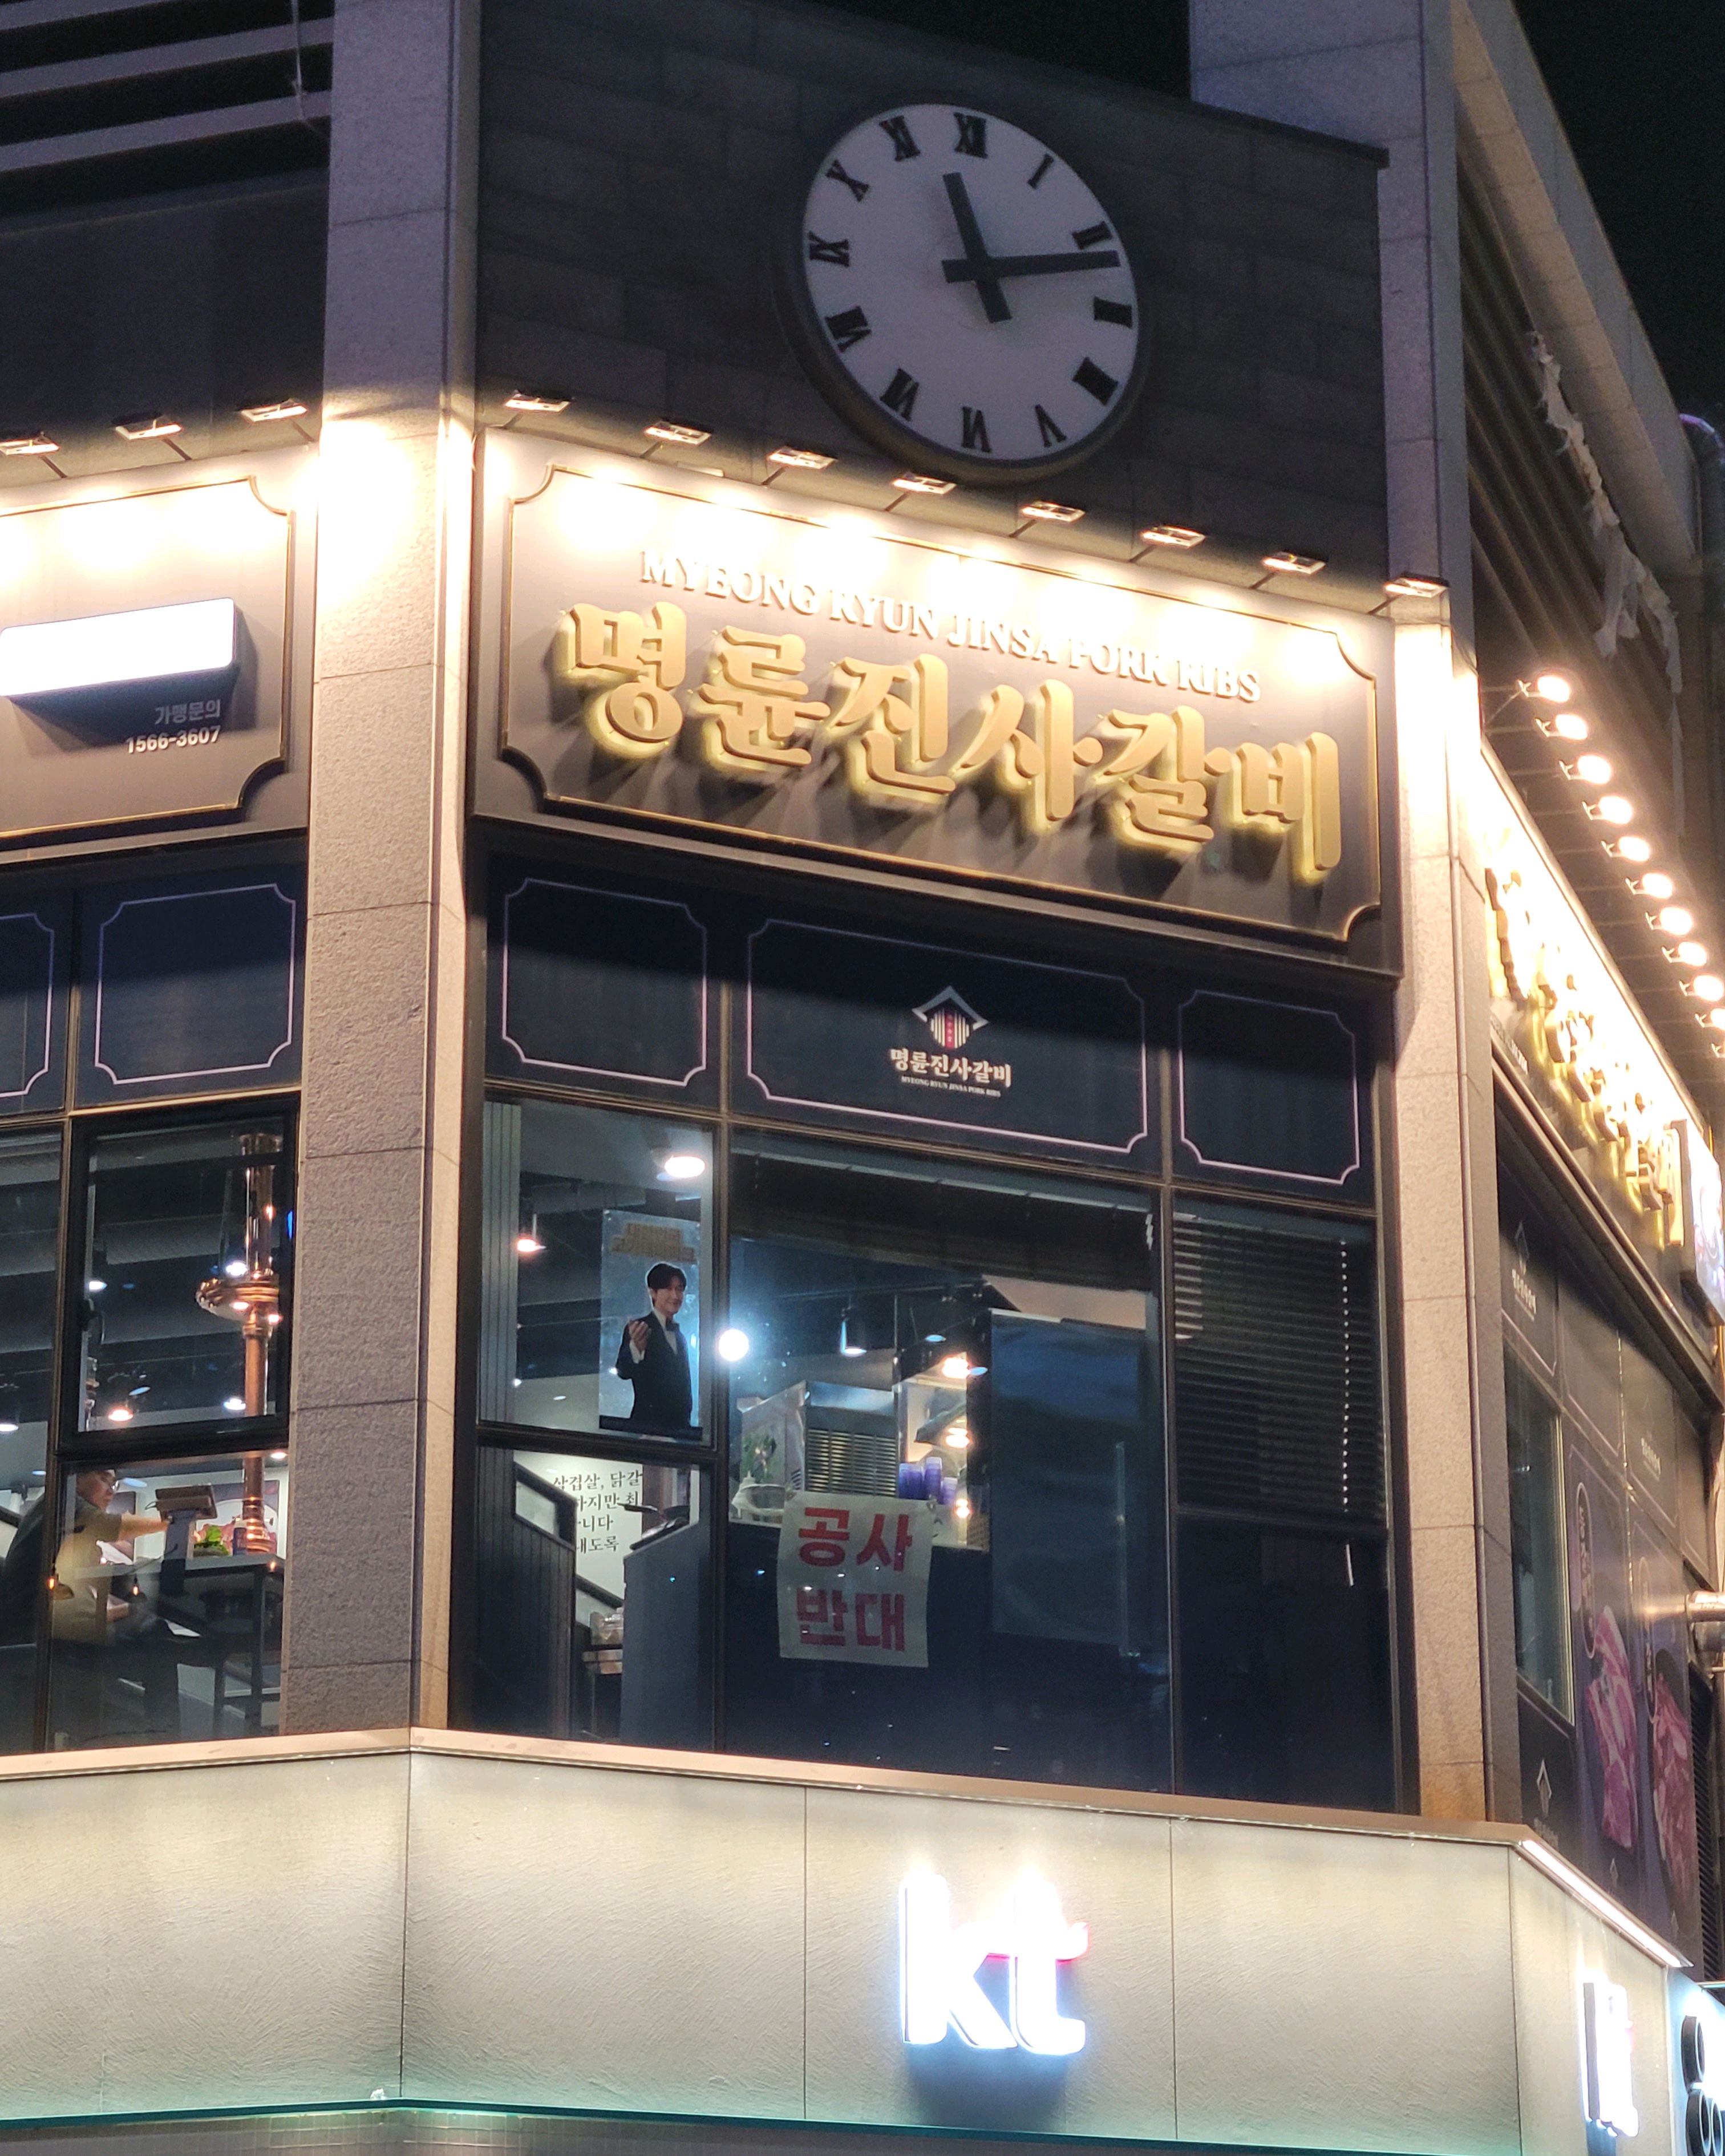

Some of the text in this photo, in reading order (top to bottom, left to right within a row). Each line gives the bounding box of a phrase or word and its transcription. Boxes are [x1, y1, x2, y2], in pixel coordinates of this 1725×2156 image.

[878, 115, 921, 162] XI
[825, 160, 870, 202] X
[640, 550, 819, 615] MYEONG
[947, 615, 1058, 664] JINSA
[1068, 637, 1171, 686] PORK
[155, 699, 221, 725] 가맹문의
[570, 600, 1341, 870] 명륜진사갈비
[127, 725, 221, 754] 1566-3607
[890, 1048, 1011, 1088] 명륜진사갈비
[578, 1514, 614, 1532] 니다
[799, 1507, 912, 1572] 공사
[796, 1587, 905, 1652] 반대
[900, 1874, 1088, 2054] kt
